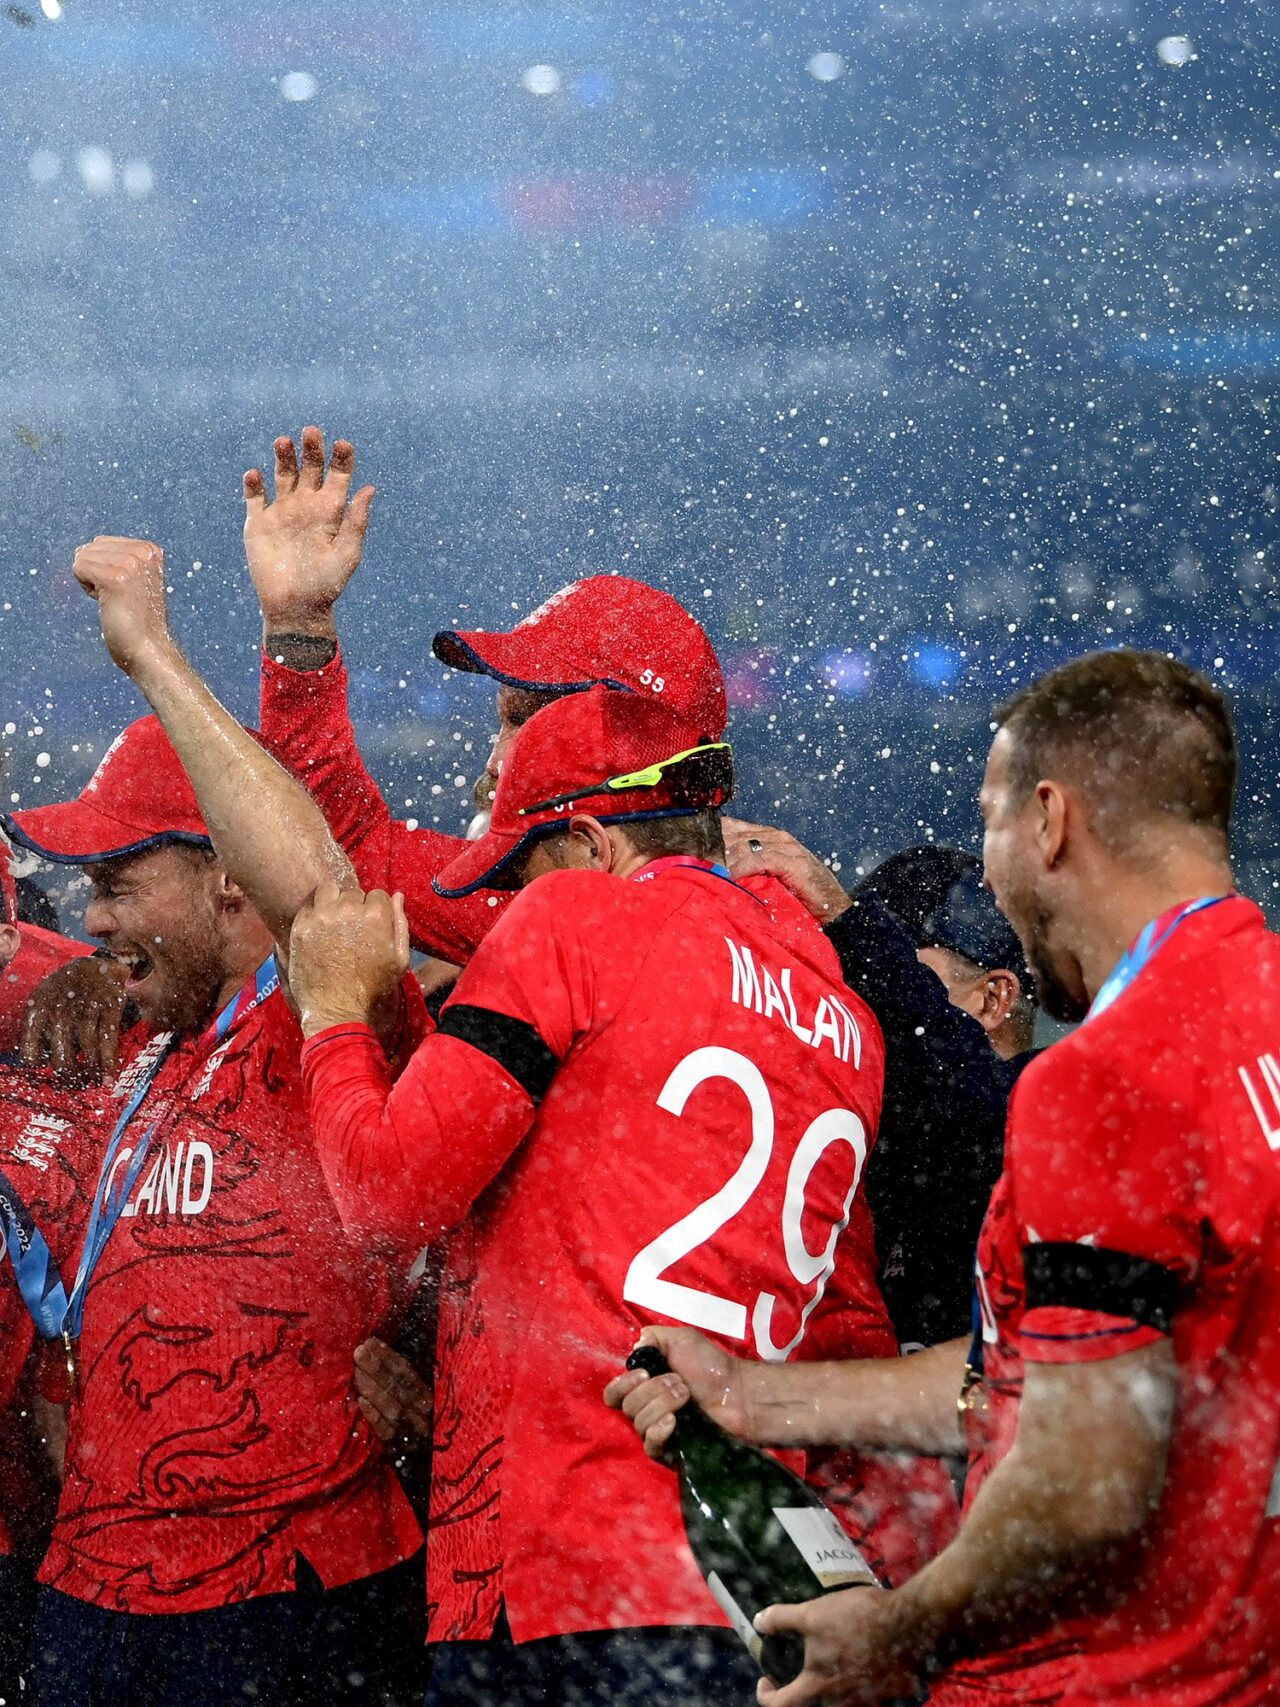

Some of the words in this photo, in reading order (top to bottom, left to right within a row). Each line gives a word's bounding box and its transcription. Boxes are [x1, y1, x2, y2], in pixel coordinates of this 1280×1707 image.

[639, 668, 665, 694] 55
[723, 935, 862, 1071] MALAN
[12, 1219, 32, 1251] 2022
[623, 1046, 867, 1363] 29
